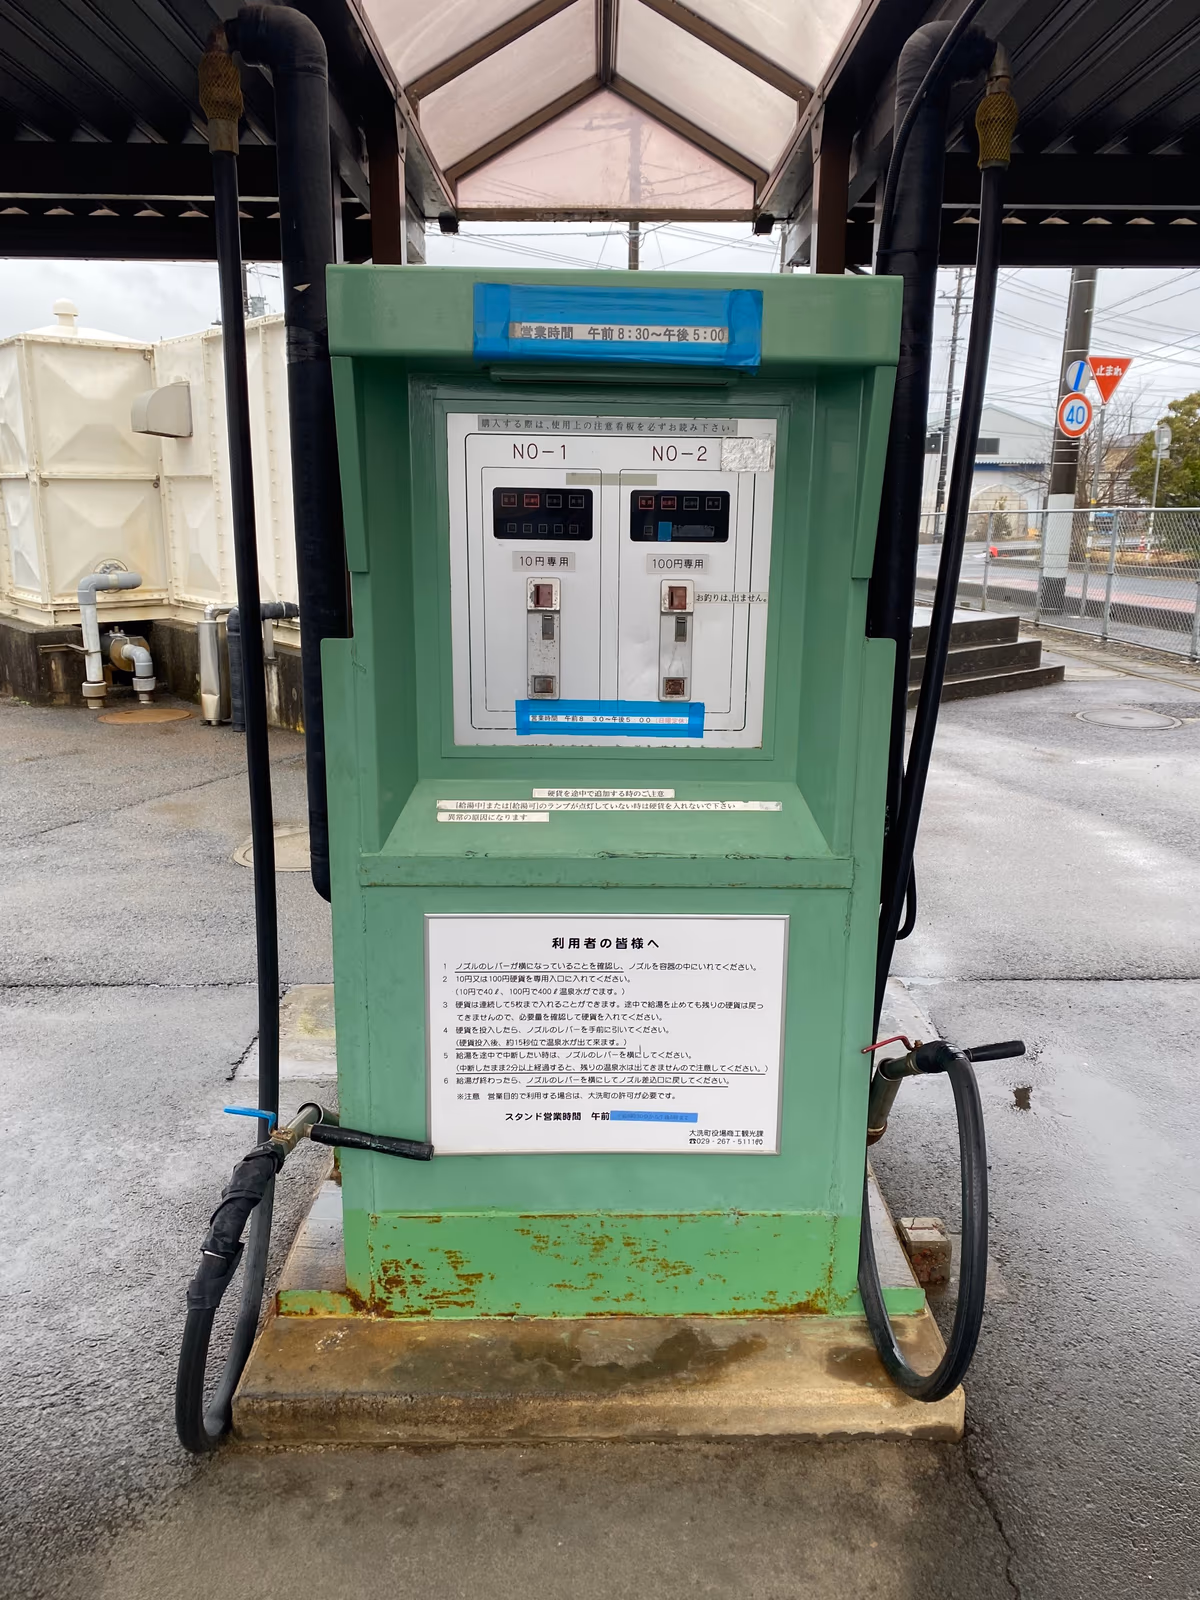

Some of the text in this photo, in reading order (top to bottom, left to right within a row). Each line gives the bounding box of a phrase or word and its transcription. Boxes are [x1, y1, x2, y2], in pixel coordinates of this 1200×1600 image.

[520, 325, 574, 340] 営業時間
[1096, 365, 1122, 376] 止まれ
[1066, 406, 1085, 425] 40
[520, 556, 569, 567] 10円専用
[652, 558, 704, 569] 100円専用
[696, 593, 767, 603] お釣りは、出ません。
[547, 790, 665, 798] 硬貨を途中で追加する時のご注意
[448, 813, 528, 821] 異常の原因になります
[552, 937, 660, 949] 利用者の皆様へ
[505, 1112, 582, 1121] スタンド営業時間
[591, 1112, 610, 1121] 午前
[689, 1129, 764, 1138] 大洗町役場商工観光課
